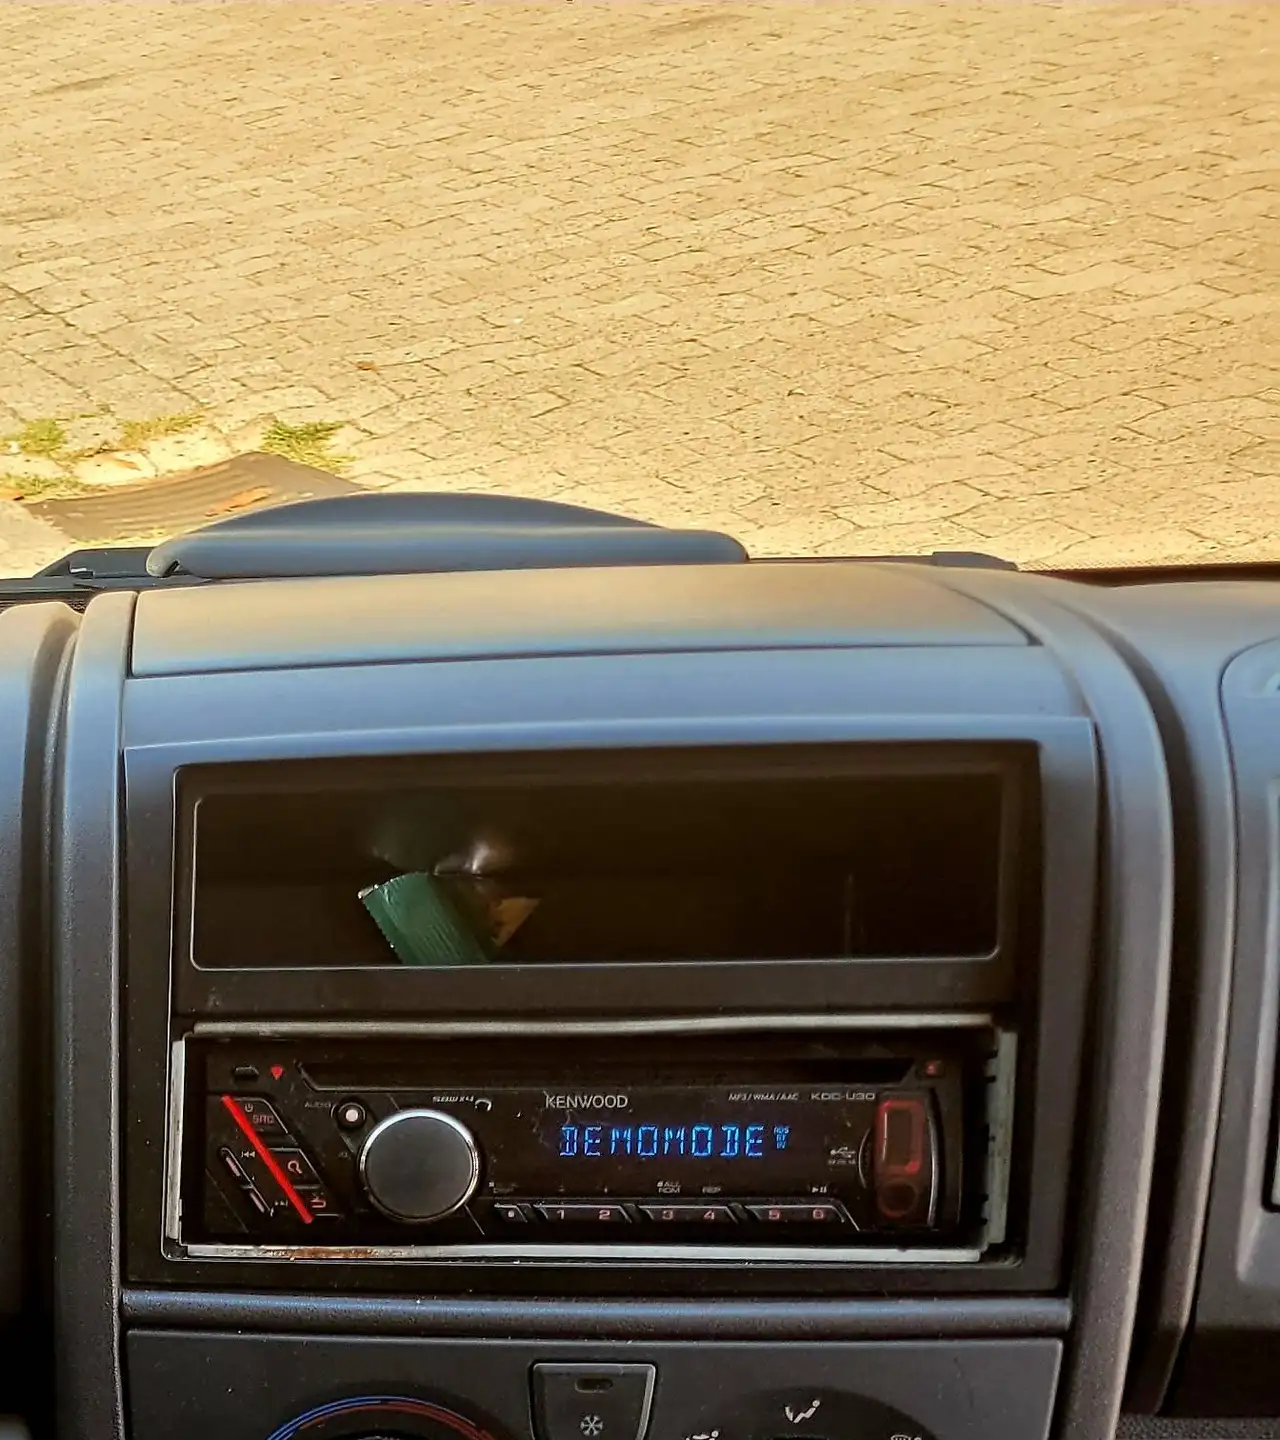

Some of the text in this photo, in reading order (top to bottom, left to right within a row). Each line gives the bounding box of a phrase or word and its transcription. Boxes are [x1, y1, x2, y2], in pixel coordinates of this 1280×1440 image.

[545, 1094, 629, 1109] KENWOOD
[556, 1209, 565, 1220] 1
[598, 1209, 611, 1220] 2
[662, 1209, 674, 1220] 3
[703, 1209, 715, 1220] 4
[768, 1209, 780, 1220] 5
